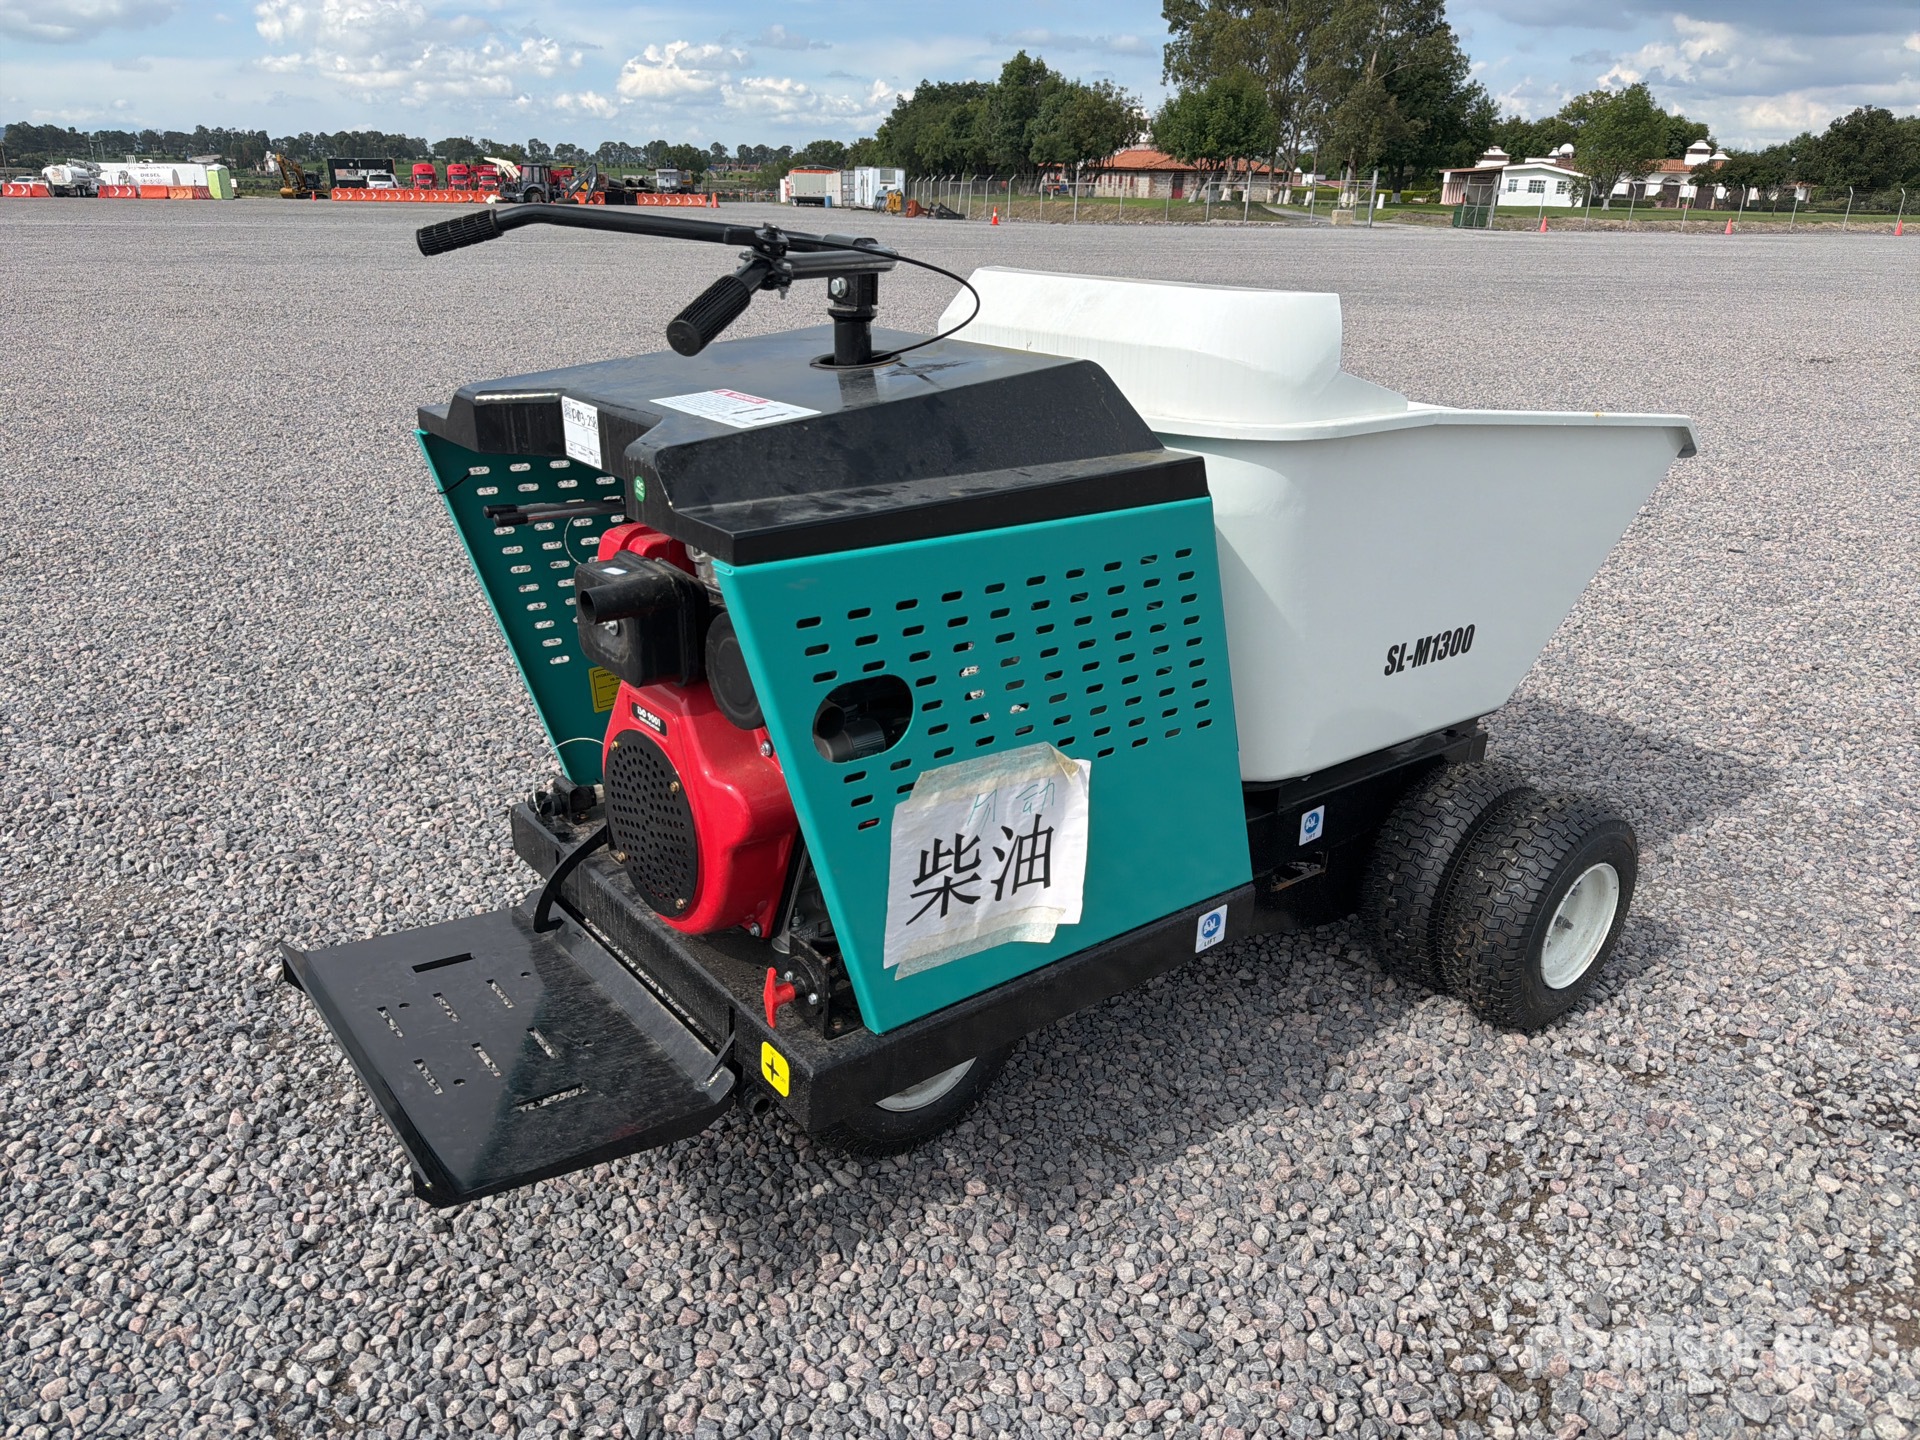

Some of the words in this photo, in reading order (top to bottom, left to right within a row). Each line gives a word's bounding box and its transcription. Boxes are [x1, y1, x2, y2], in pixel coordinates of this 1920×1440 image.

[1383, 623, 1476, 677] SL-M1300
[906, 813, 1055, 926] 柴油
[1203, 937, 1217, 947] LIFT
